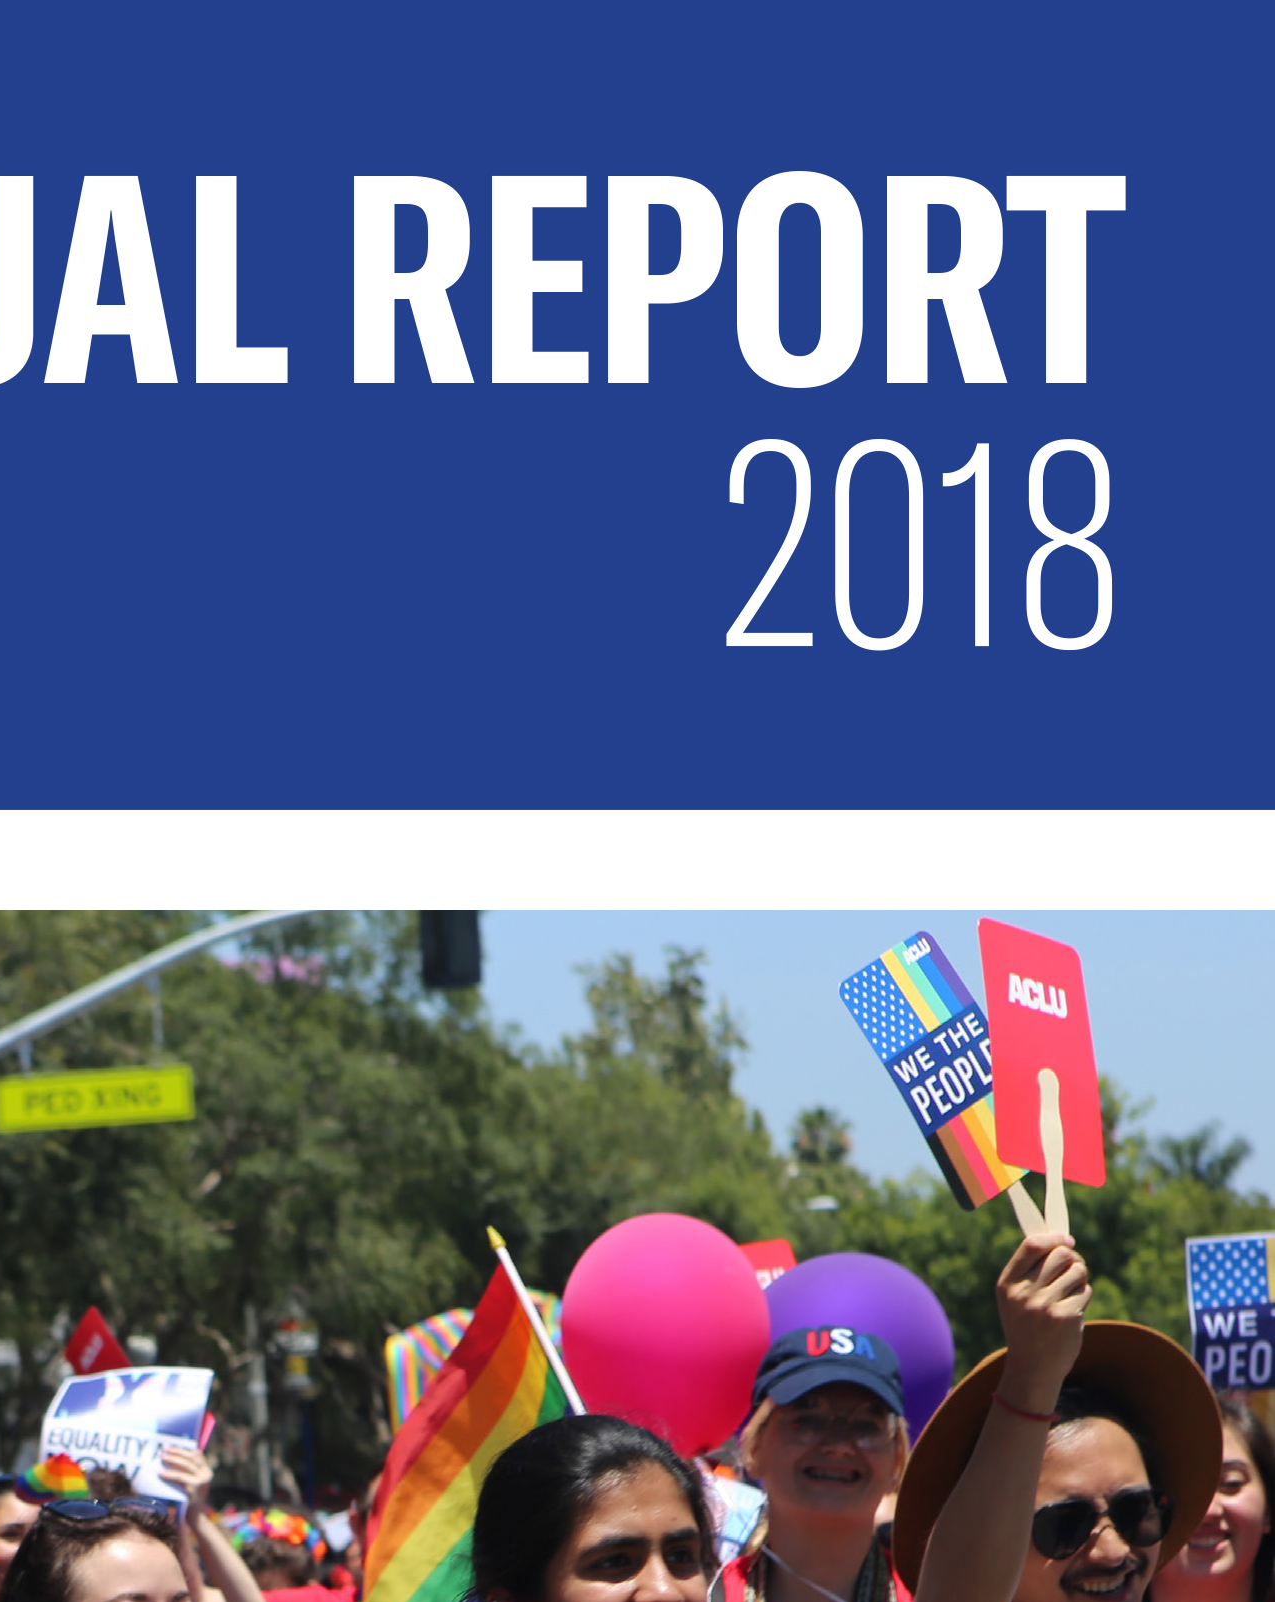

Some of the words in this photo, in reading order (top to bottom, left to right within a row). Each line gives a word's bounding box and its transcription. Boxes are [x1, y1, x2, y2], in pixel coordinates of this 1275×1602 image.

[902, 938, 932, 966] ACLU
[1008, 972, 1068, 1019] ACLU
[893, 1046, 935, 1084] WE
[933, 1012, 984, 1055] THE
[24, 1087, 85, 1115] PED
[91, 1080, 163, 1111] XING
[1202, 1309, 1258, 1340] WE
[806, 1327, 876, 1361] USA
[48, 1427, 149, 1458] EQUALITY
